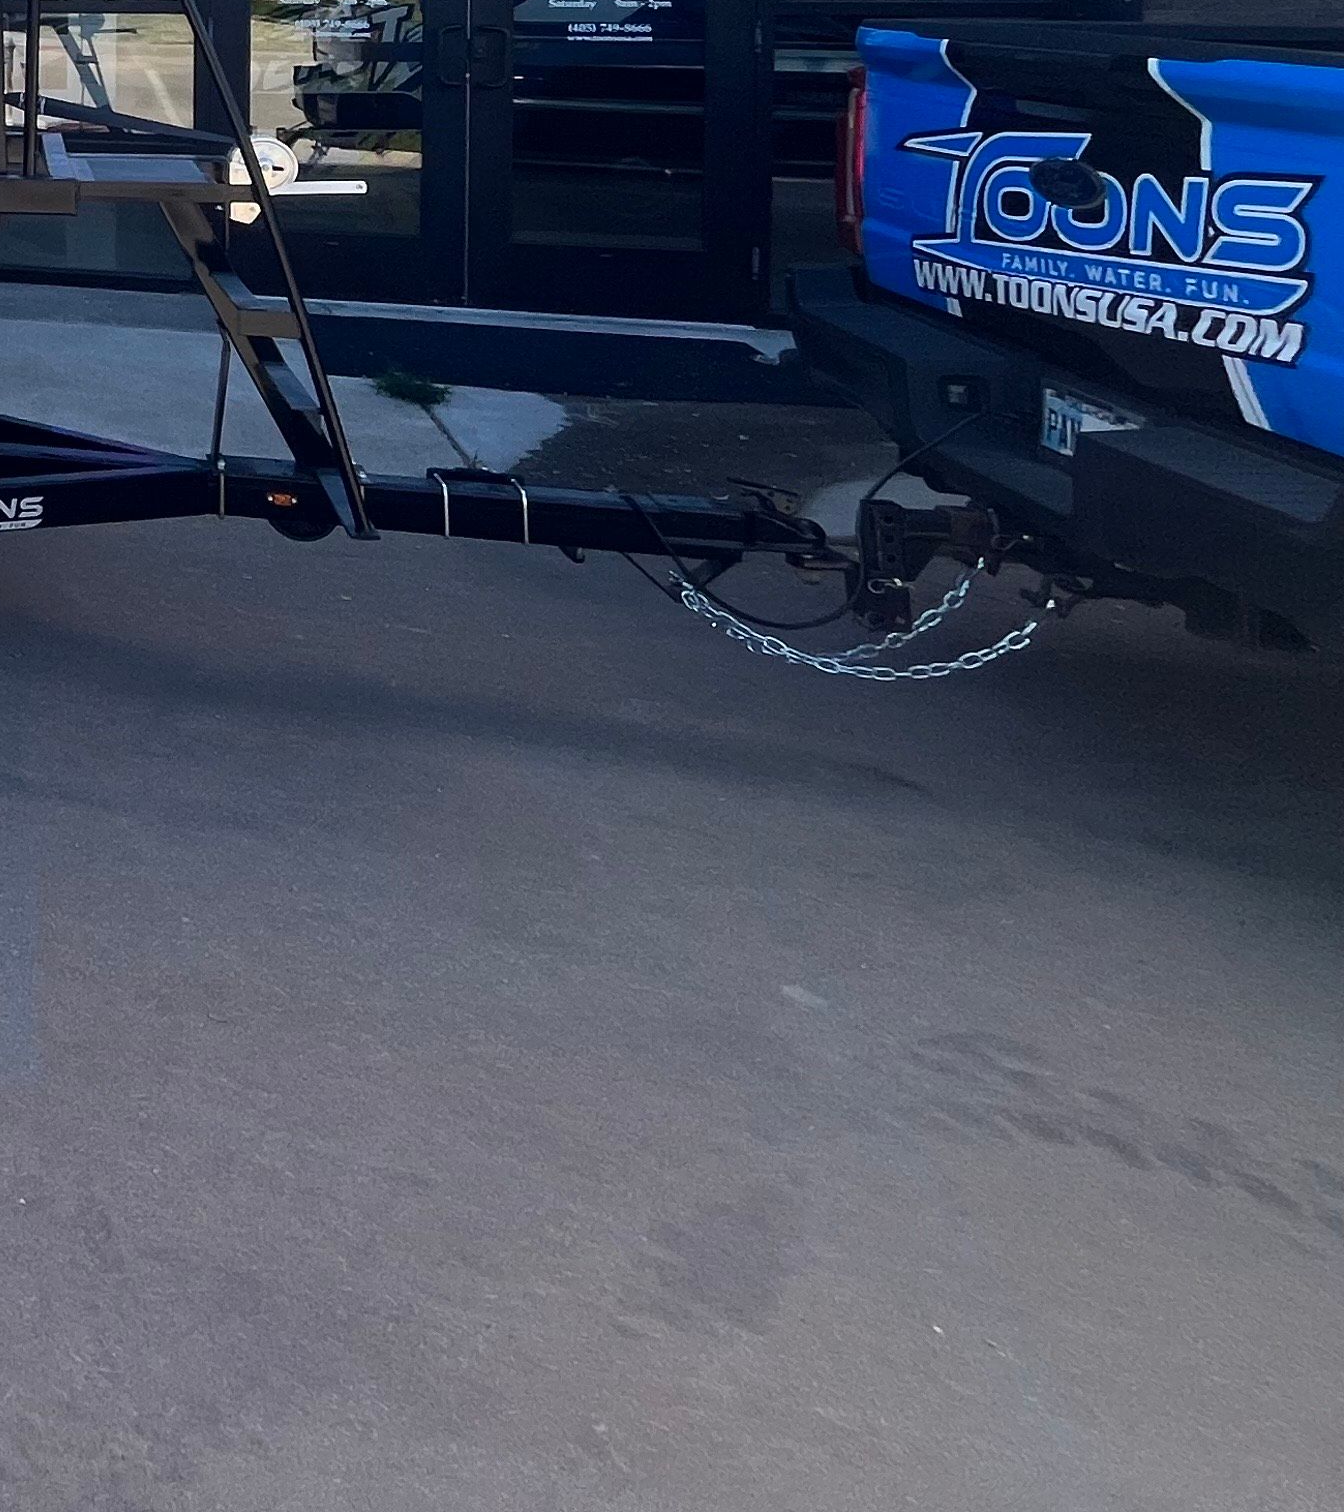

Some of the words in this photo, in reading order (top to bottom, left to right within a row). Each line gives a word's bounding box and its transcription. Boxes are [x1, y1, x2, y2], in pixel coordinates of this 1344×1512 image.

[904, 132, 1313, 272] TOONS
[913, 259, 1304, 363] WWW.TOONSUSA.COM
[1002, 252, 1076, 279] FAMILY.
[1084, 263, 1172, 293] WATER.
[1185, 278, 1250, 306] FUN.
